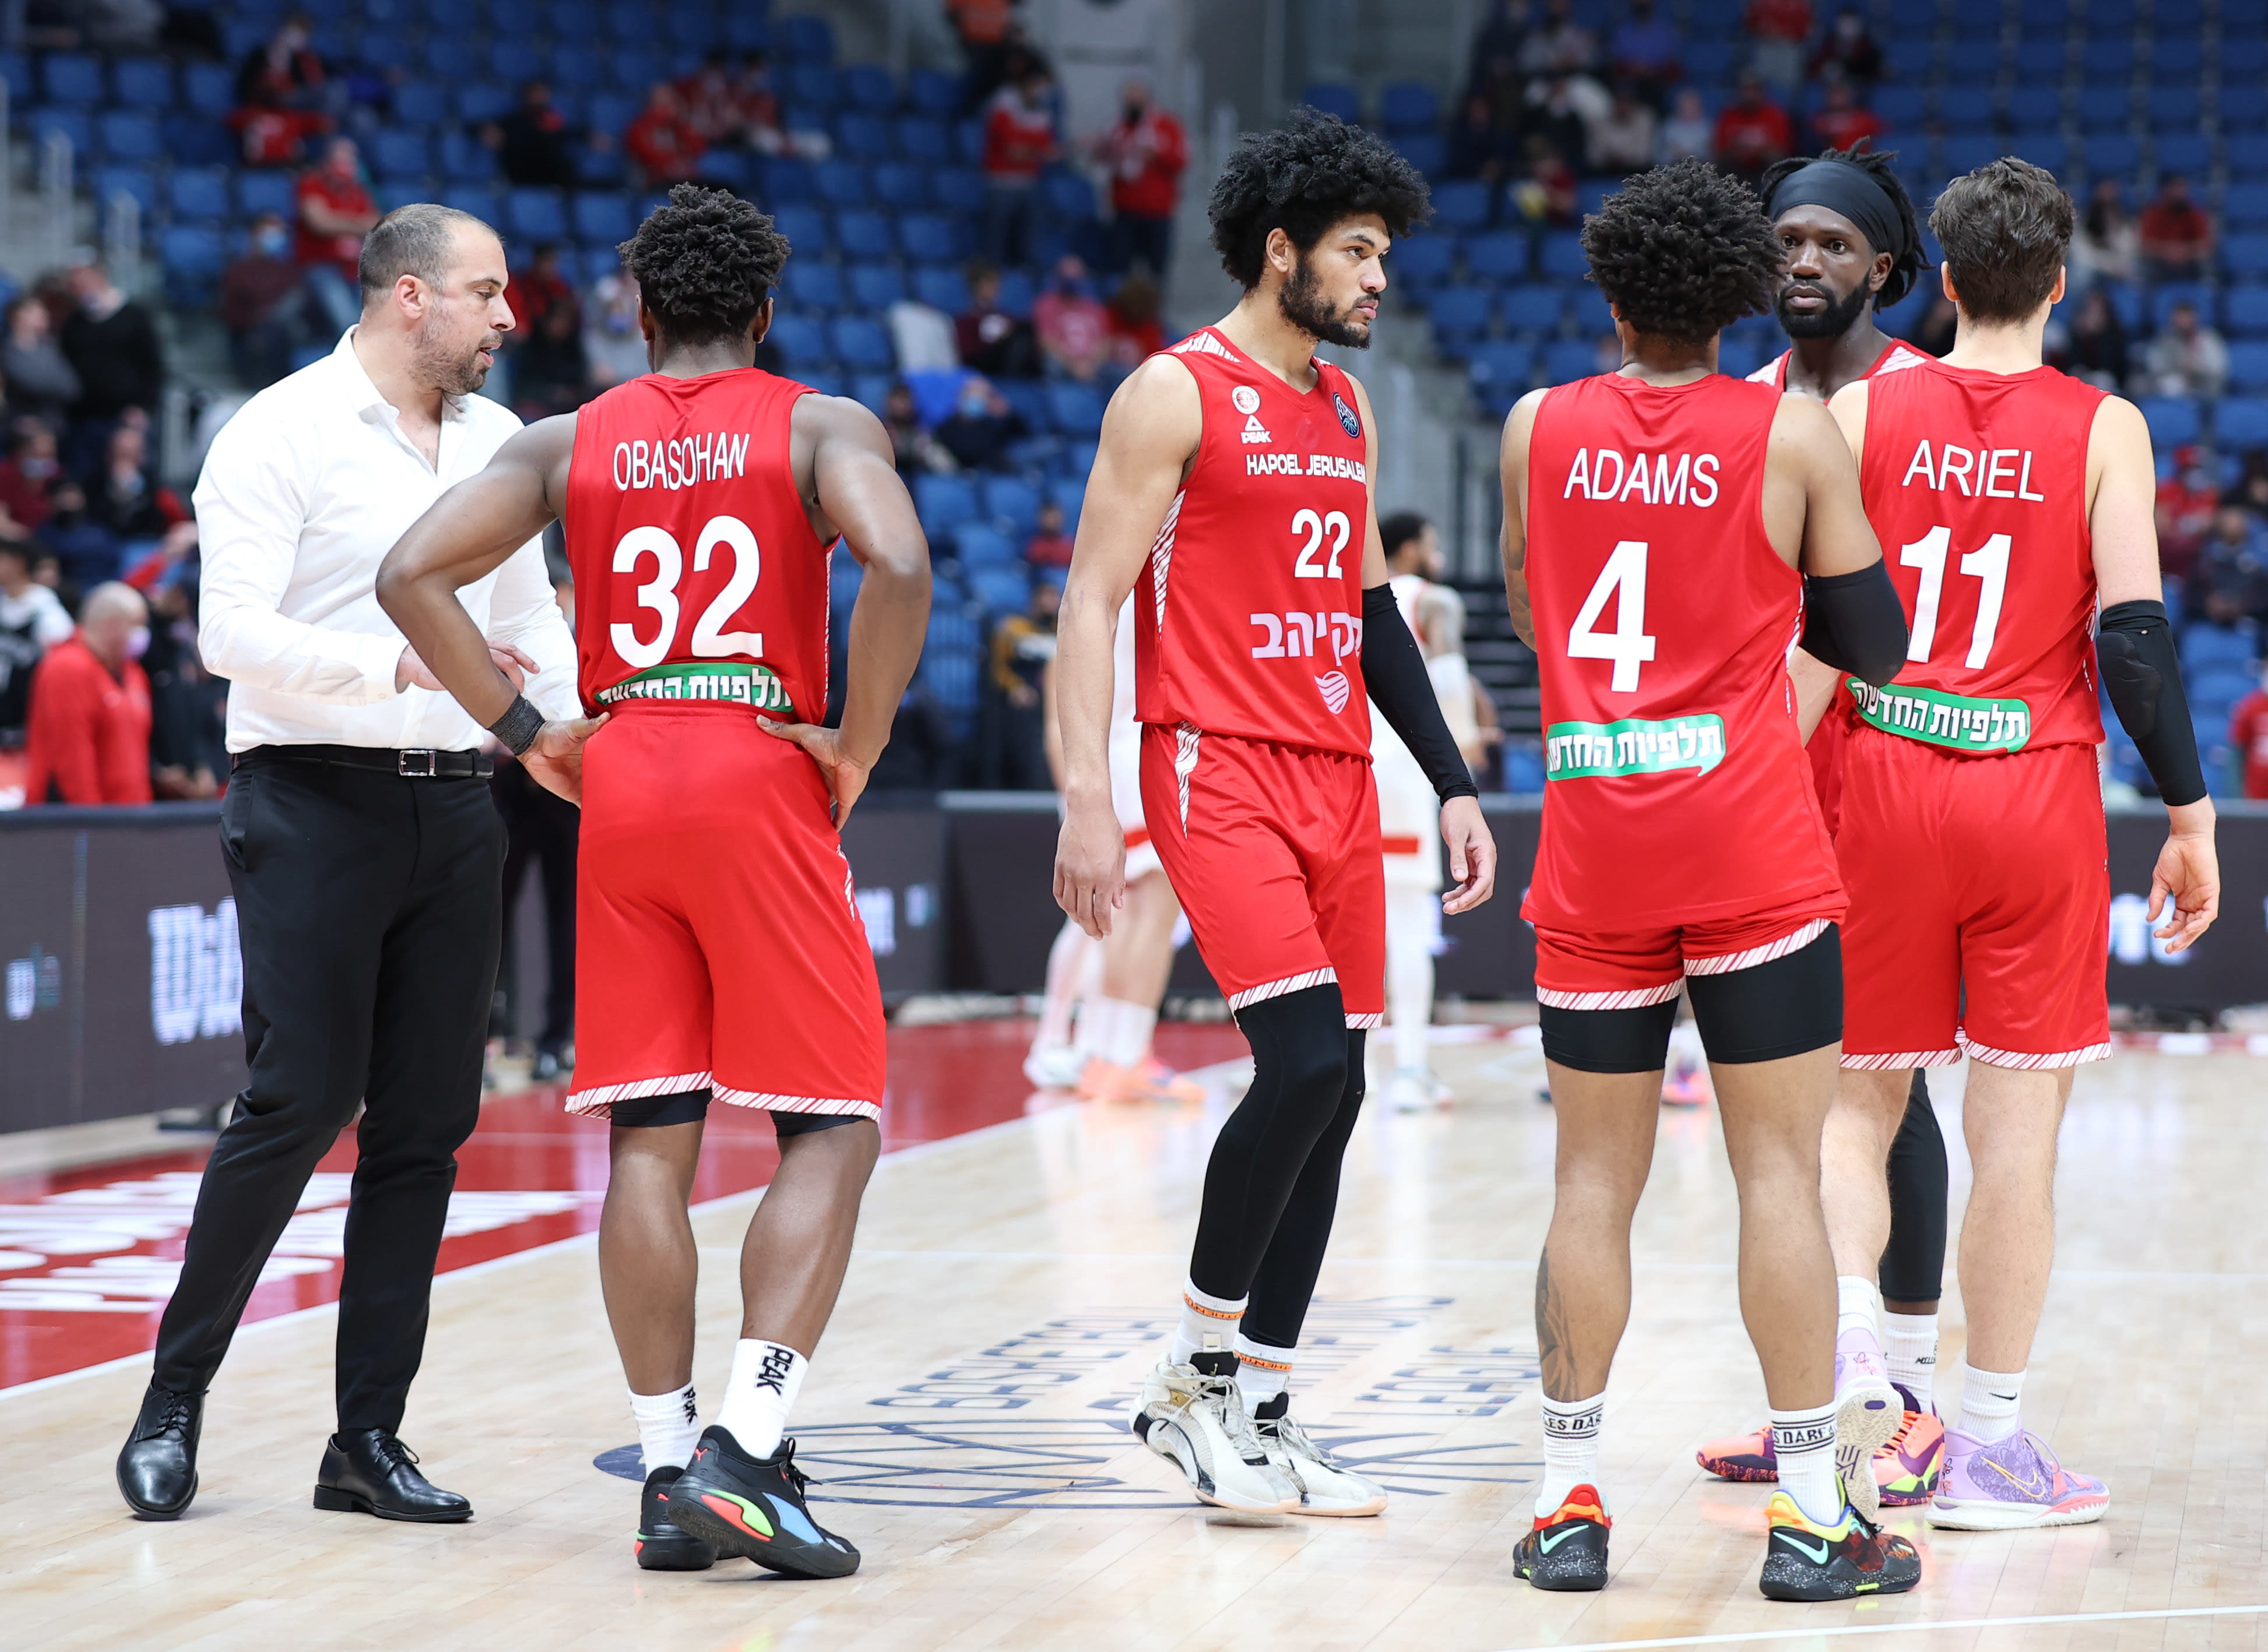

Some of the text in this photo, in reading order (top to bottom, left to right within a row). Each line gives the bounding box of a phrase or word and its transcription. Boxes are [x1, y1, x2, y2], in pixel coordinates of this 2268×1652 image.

[613, 431, 751, 491] OBASOHAN
[1240, 431, 1273, 445] PEAK
[1246, 453, 1366, 485] HAPOEL JERUSALEM
[1563, 448, 1720, 508] ADAMS
[1901, 439, 2045, 502] ARIEL
[1291, 508, 1351, 580] 22
[610, 515, 764, 668] 32
[1567, 540, 1656, 692] 4
[1899, 526, 2012, 670] 11
[1851, 682, 2027, 742] תלפיות החדשה
[1616, 721, 1723, 767] תלפיות
[753, 1343, 799, 1400] PEAK
